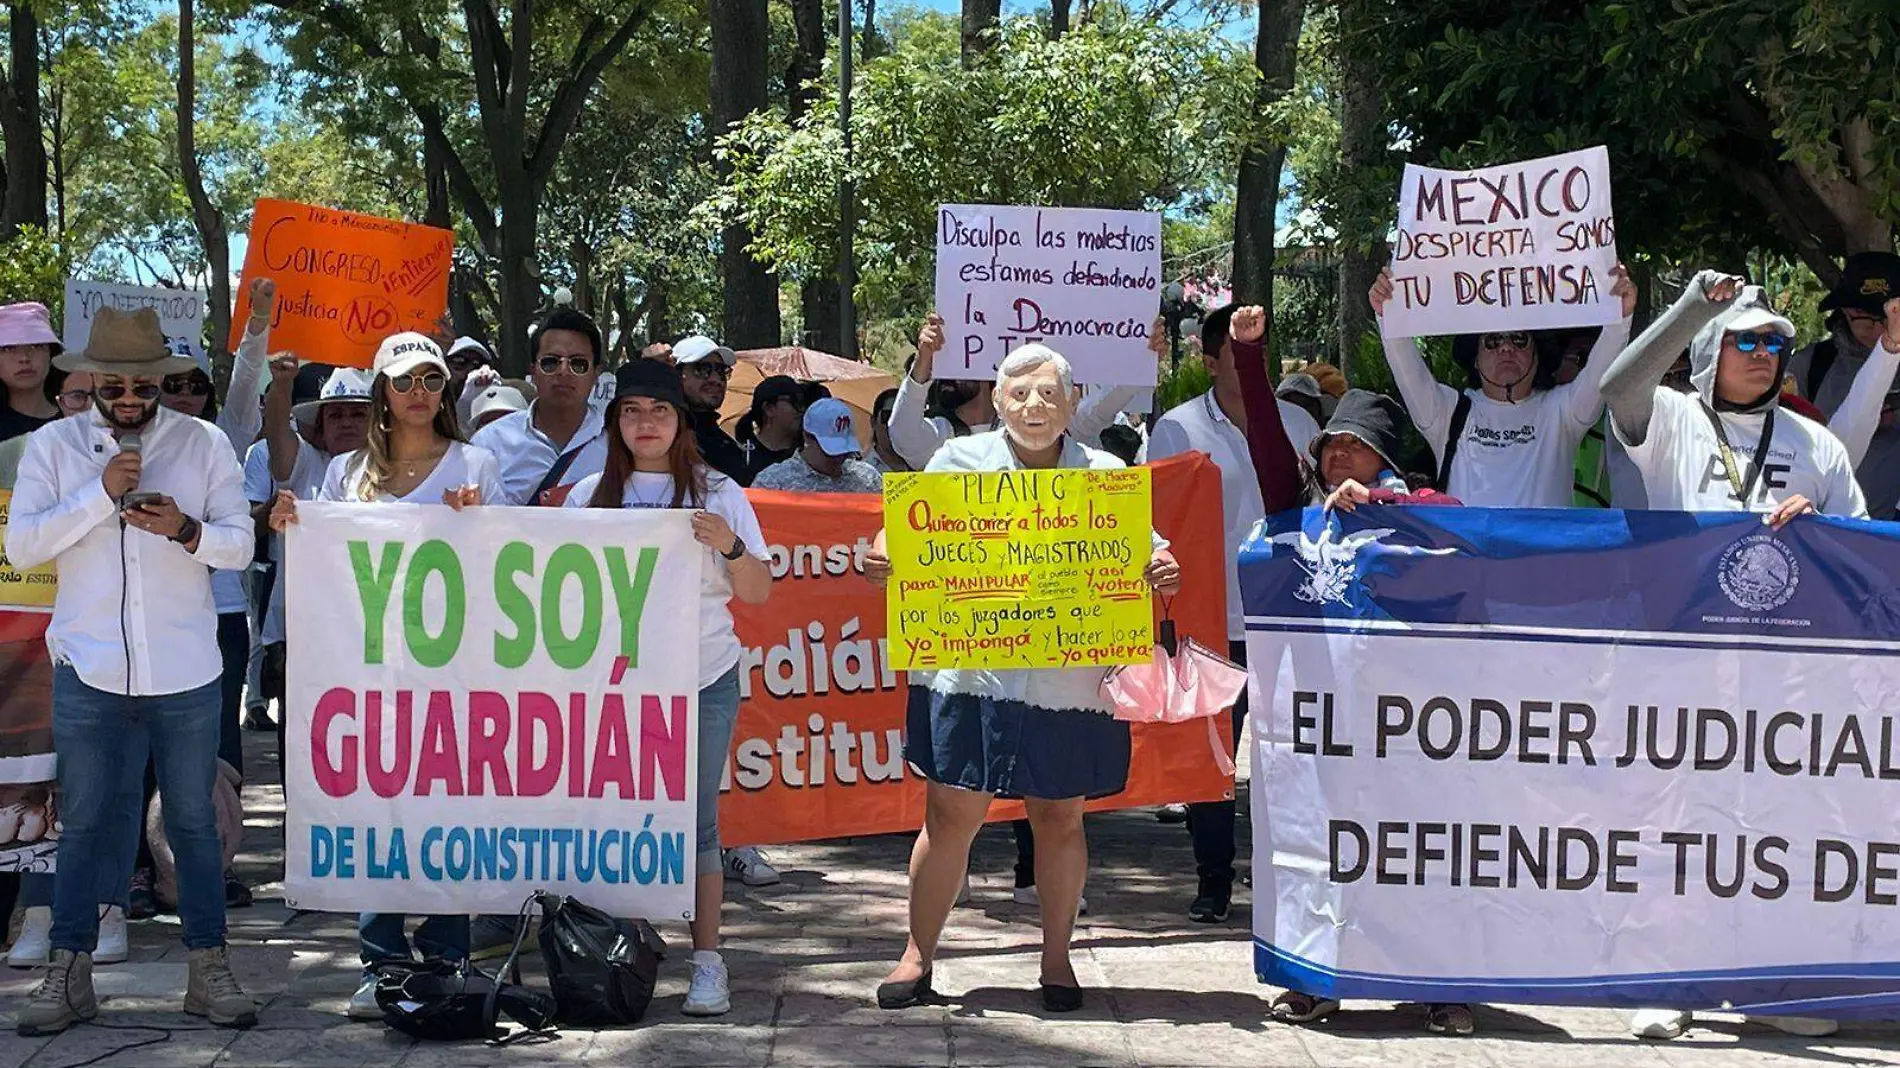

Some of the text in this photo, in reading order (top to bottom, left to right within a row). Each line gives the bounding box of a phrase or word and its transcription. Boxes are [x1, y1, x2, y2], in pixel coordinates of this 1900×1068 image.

[1416, 166, 1590, 225] MÉXICO
[264, 216, 381, 284] CONGRESO
[941, 209, 1155, 257] Disculpa las molestias
[1396, 216, 1615, 261] DESPIERTA SOMOS
[959, 256, 1156, 290] estamos defendiendo
[1396, 264, 1599, 309] TU DEFENSA
[76, 290, 104, 319] YO
[271, 290, 340, 328] justicia
[347, 301, 393, 334] NO
[965, 293, 1149, 338] la Democracia
[393, 341, 439, 357] ESPAÑA
[908, 500, 1118, 533] Quiero correr a todos los
[918, 539, 988, 566] JUECES
[1008, 537, 1131, 566] MAGISTRADOS
[900, 573, 1031, 601] para MANIPULAR
[1084, 567, 1094, 588] y
[347, 539, 660, 669] YO SOY
[900, 601, 1102, 637] por los juzgadores que
[905, 637, 932, 667] yo
[1043, 631, 1052, 652] y
[1056, 625, 1103, 647] hacer
[1112, 620, 1125, 643] lo
[311, 656, 688, 801] GUARDIÁN
[1292, 691, 1900, 781] EL PODER JUDICIAL
[311, 813, 685, 884] DE LA CONSTITUCIÓN
[1328, 819, 1640, 894] DEFIENDE
[1662, 831, 1789, 902] TUS
